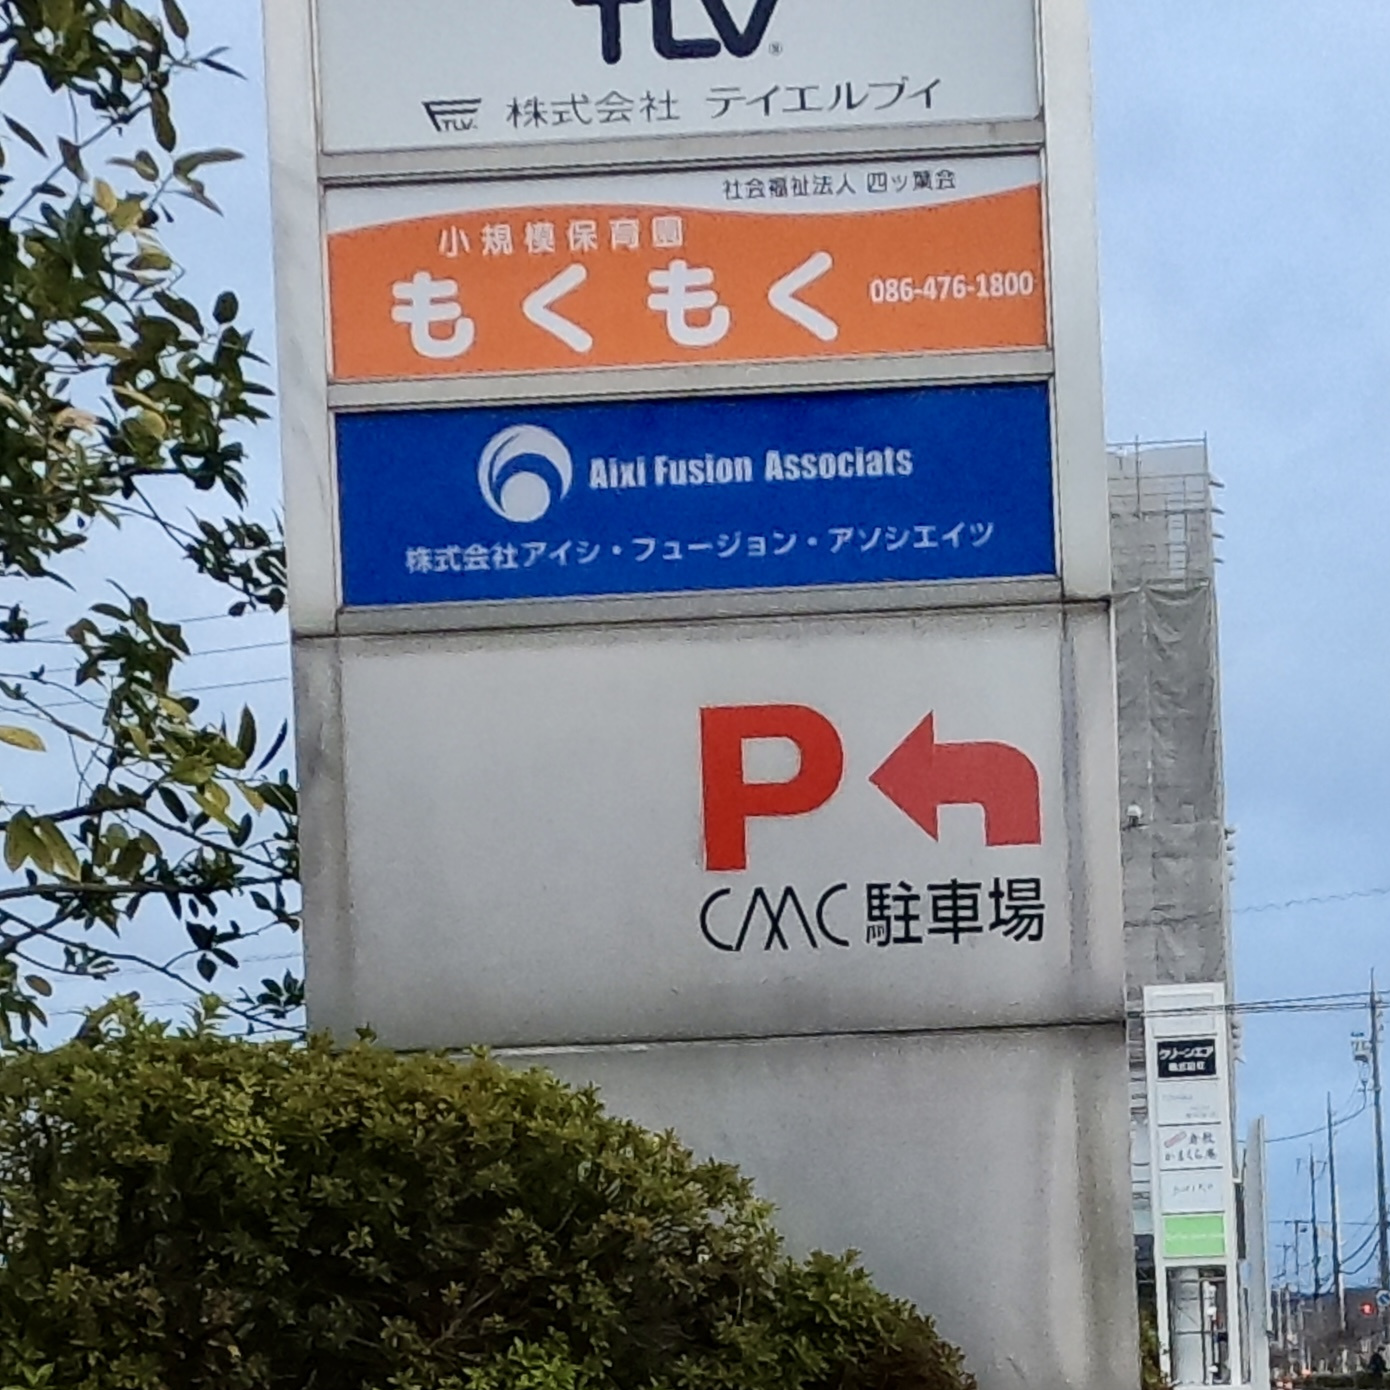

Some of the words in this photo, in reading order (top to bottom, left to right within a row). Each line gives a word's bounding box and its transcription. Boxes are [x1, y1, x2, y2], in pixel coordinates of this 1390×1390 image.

[572, 0, 778, 65] TLV
[506, 90, 680, 129] 株式会社
[706, 76, 941, 119] テイエルブイ
[723, 173, 856, 200] 社会福祉法人
[438, 216, 684, 258] 小規模保育園
[390, 250, 839, 360] もくもく
[869, 271, 1035, 303] 086-476-1800
[588, 456, 647, 489] Aixi
[653, 452, 753, 487] Fusion
[764, 446, 914, 482] Associats
[700, 704, 844, 871] P
[865, 876, 1046, 948] 駐車場
